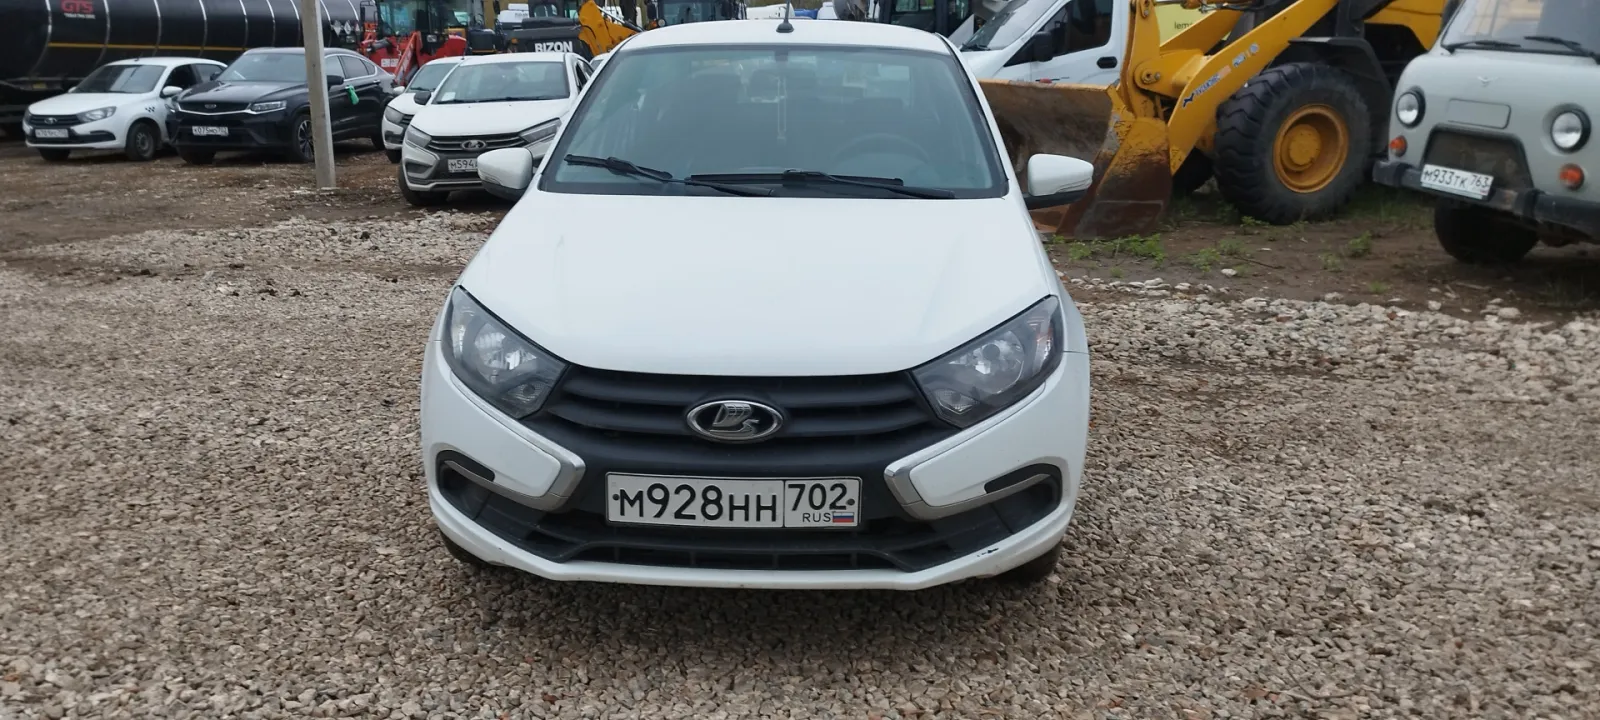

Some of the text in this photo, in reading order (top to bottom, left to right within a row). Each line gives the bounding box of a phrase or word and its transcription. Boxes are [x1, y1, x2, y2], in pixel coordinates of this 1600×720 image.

[61, 0, 94, 13] GTS
[534, 41, 573, 53] BIZON
[1470, 174, 1489, 188] 763
[619, 483, 848, 522] М928НН 702
[802, 512, 831, 523] RUS
